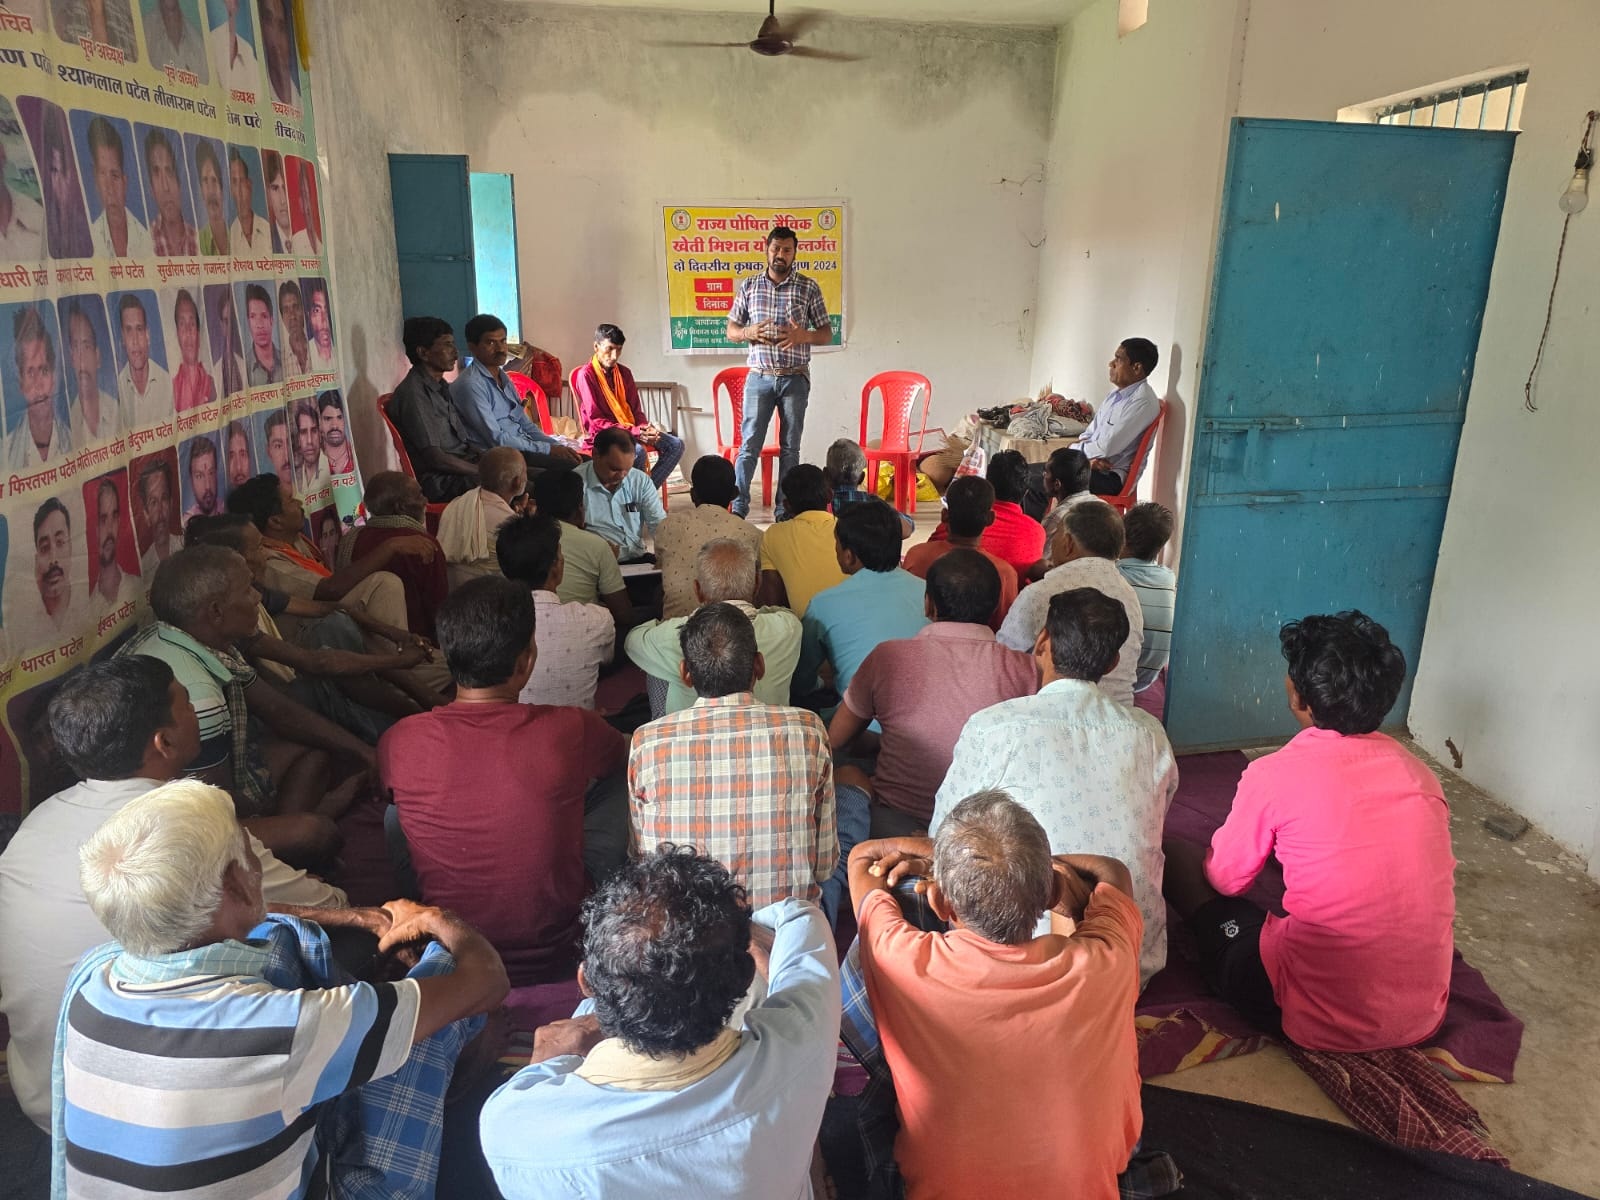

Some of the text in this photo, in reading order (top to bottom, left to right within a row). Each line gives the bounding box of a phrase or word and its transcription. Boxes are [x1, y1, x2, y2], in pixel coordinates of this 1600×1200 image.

[57, 64, 123, 95] श्यामलाल
[125, 78, 150, 102] पटेल
[152, 84, 195, 113] लीलाराम
[197, 98, 216, 119] पटेल
[697, 217, 726, 231] राज्य
[730, 214, 769, 231] पोषित
[672, 235, 705, 253] खेती
[709, 236, 750, 253] मिशन
[0, 264, 31, 288] धारी
[72, 262, 95, 282] पटेल
[125, 260, 145, 279] पटेल
[674, 258, 685, 273] दो
[689, 258, 730, 273] दिवसीय
[734, 263, 764, 275] कृषक
[814, 260, 837, 271] 2024
[706, 281, 723, 292] ग्राम
[703, 298, 729, 310] दिनांक
[8, 468, 58, 497] फिरतराम
[59, 458, 77, 480] पटेल
[77, 448, 109, 471] मोतीलाल
[110, 438, 126, 456] पटेल
[156, 421, 173, 439] पटेल
[202, 406, 219, 423] पटेल
[342, 475, 356, 486] पटे
[118, 600, 137, 622] पटेल
[20, 649, 56, 673] भारत
[59, 637, 84, 658] पटेल
